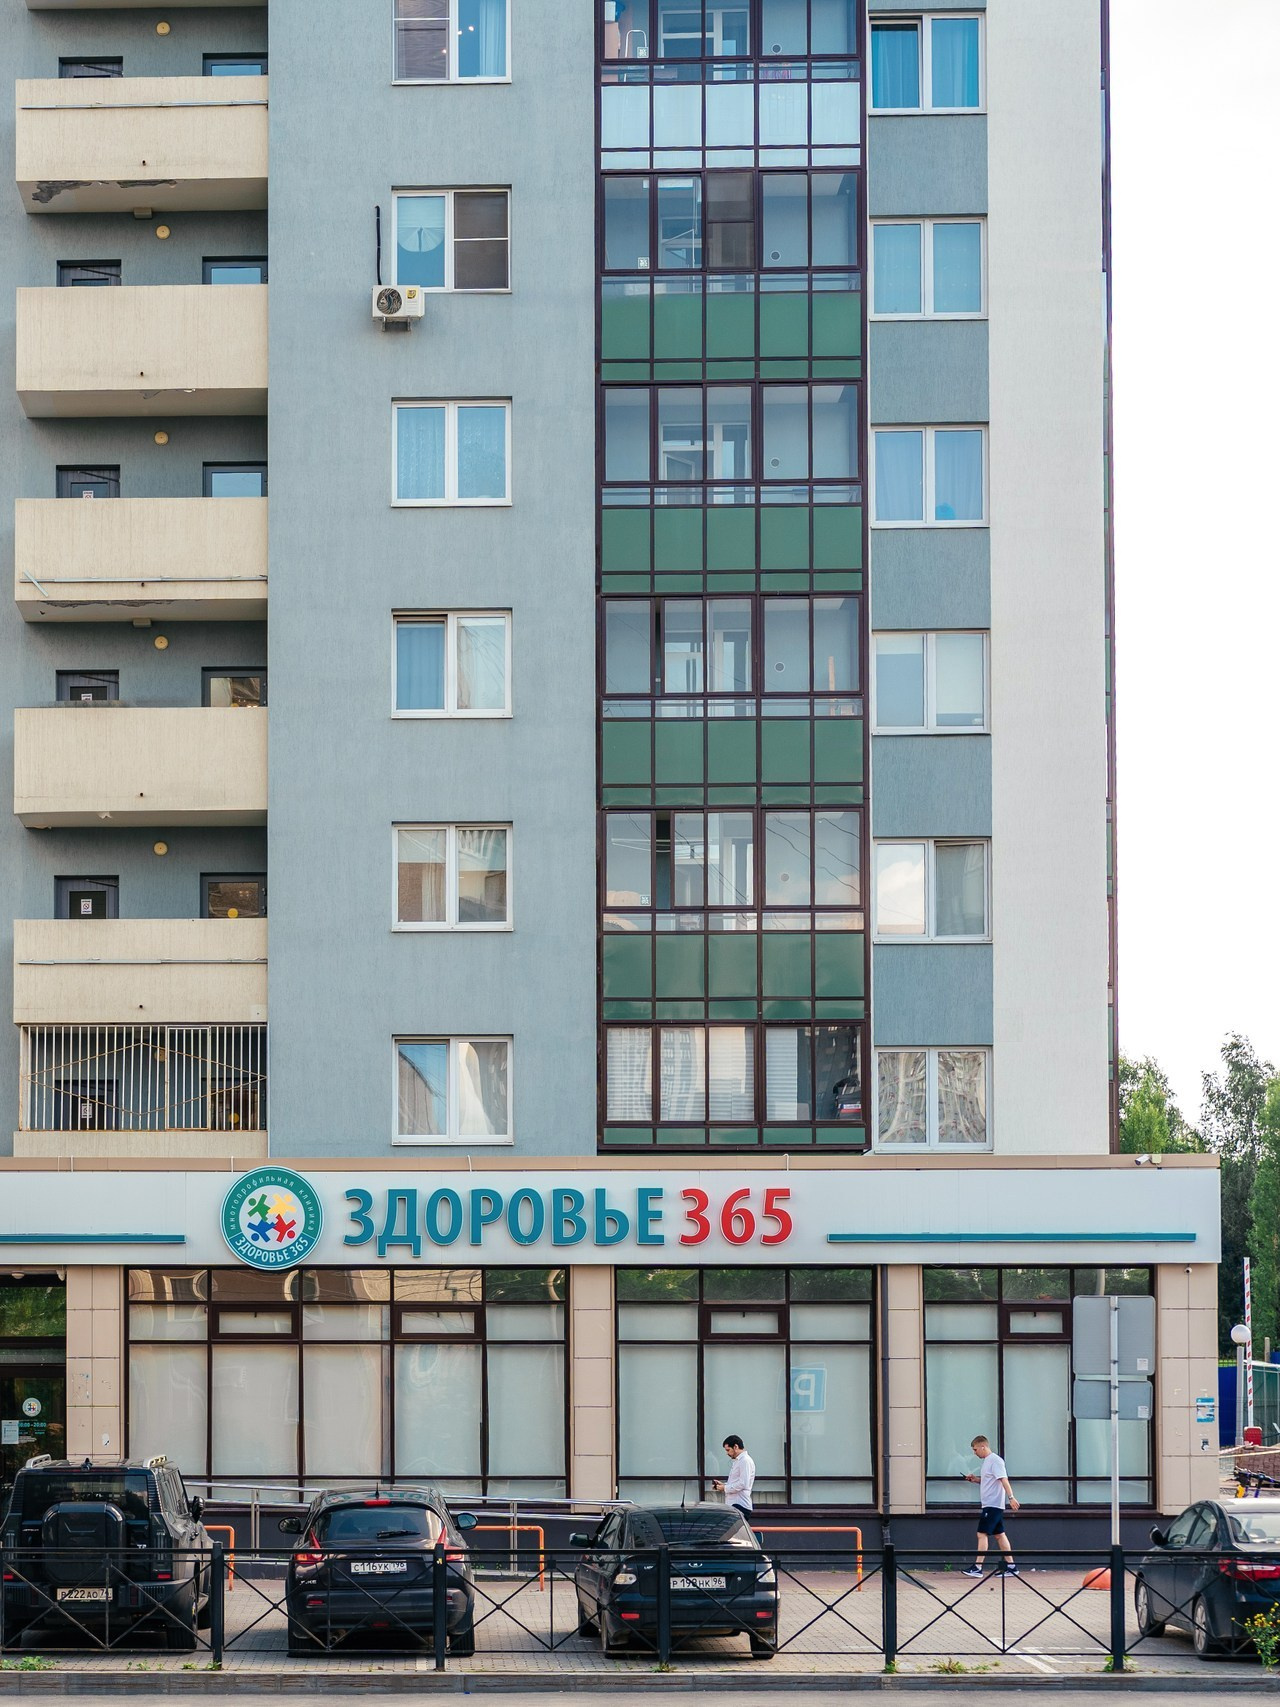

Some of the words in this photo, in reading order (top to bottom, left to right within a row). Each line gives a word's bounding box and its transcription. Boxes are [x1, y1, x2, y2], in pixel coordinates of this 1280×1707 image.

[229, 1175, 295, 1230] многопрофильная
[298, 1188, 315, 1231] клиника
[342, 1187, 666, 1258] ЗДОРОВЬЕ
[678, 1187, 794, 1246] 365
[235, 1236, 291, 1263] ЗДОРОВЬЕ
[289, 1236, 309, 1257] 365
[353, 1563, 389, 1572] С116УК
